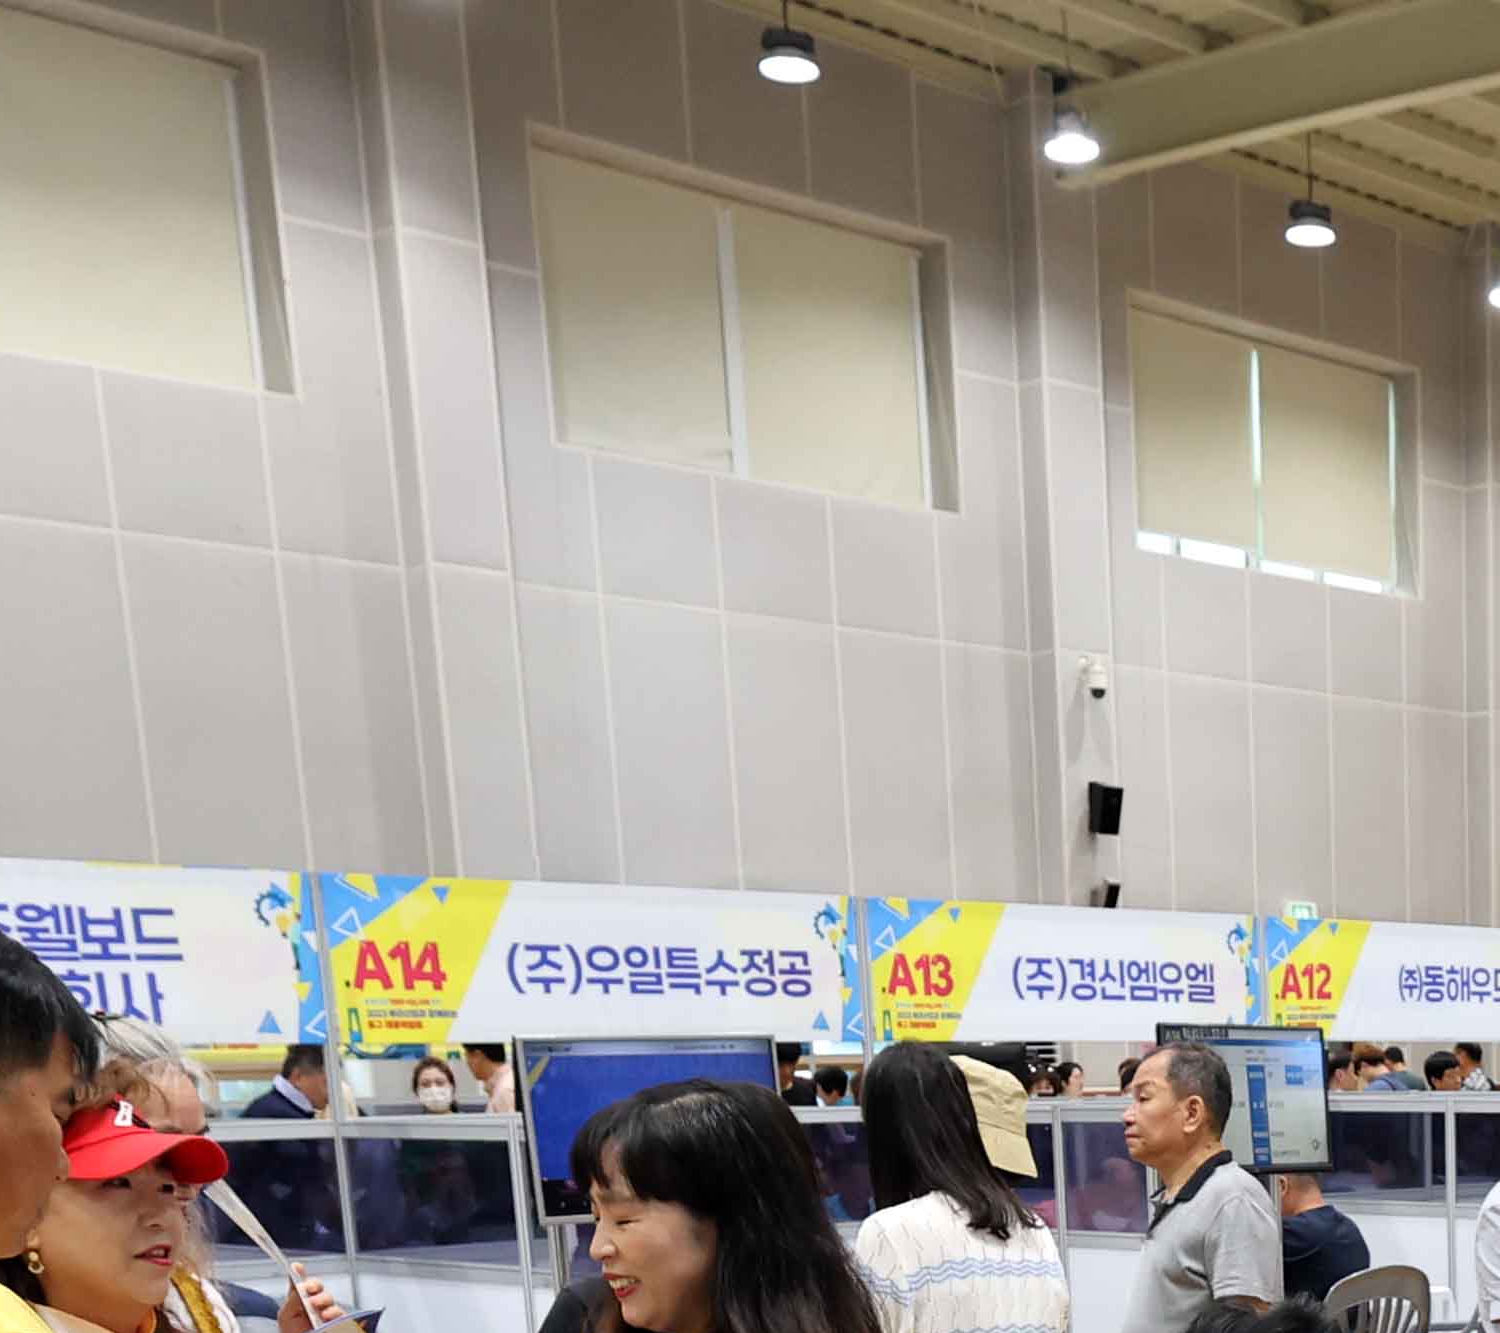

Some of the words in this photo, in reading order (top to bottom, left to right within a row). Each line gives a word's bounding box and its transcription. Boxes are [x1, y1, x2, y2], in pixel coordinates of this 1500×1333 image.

[354, 940, 448, 991] A14
[505, 941, 814, 998] (주)우일특수정공
[887, 953, 954, 997] A13
[1011, 955, 1216, 1004] (주)경신엠유엘
[1279, 962, 1332, 1002] A12
